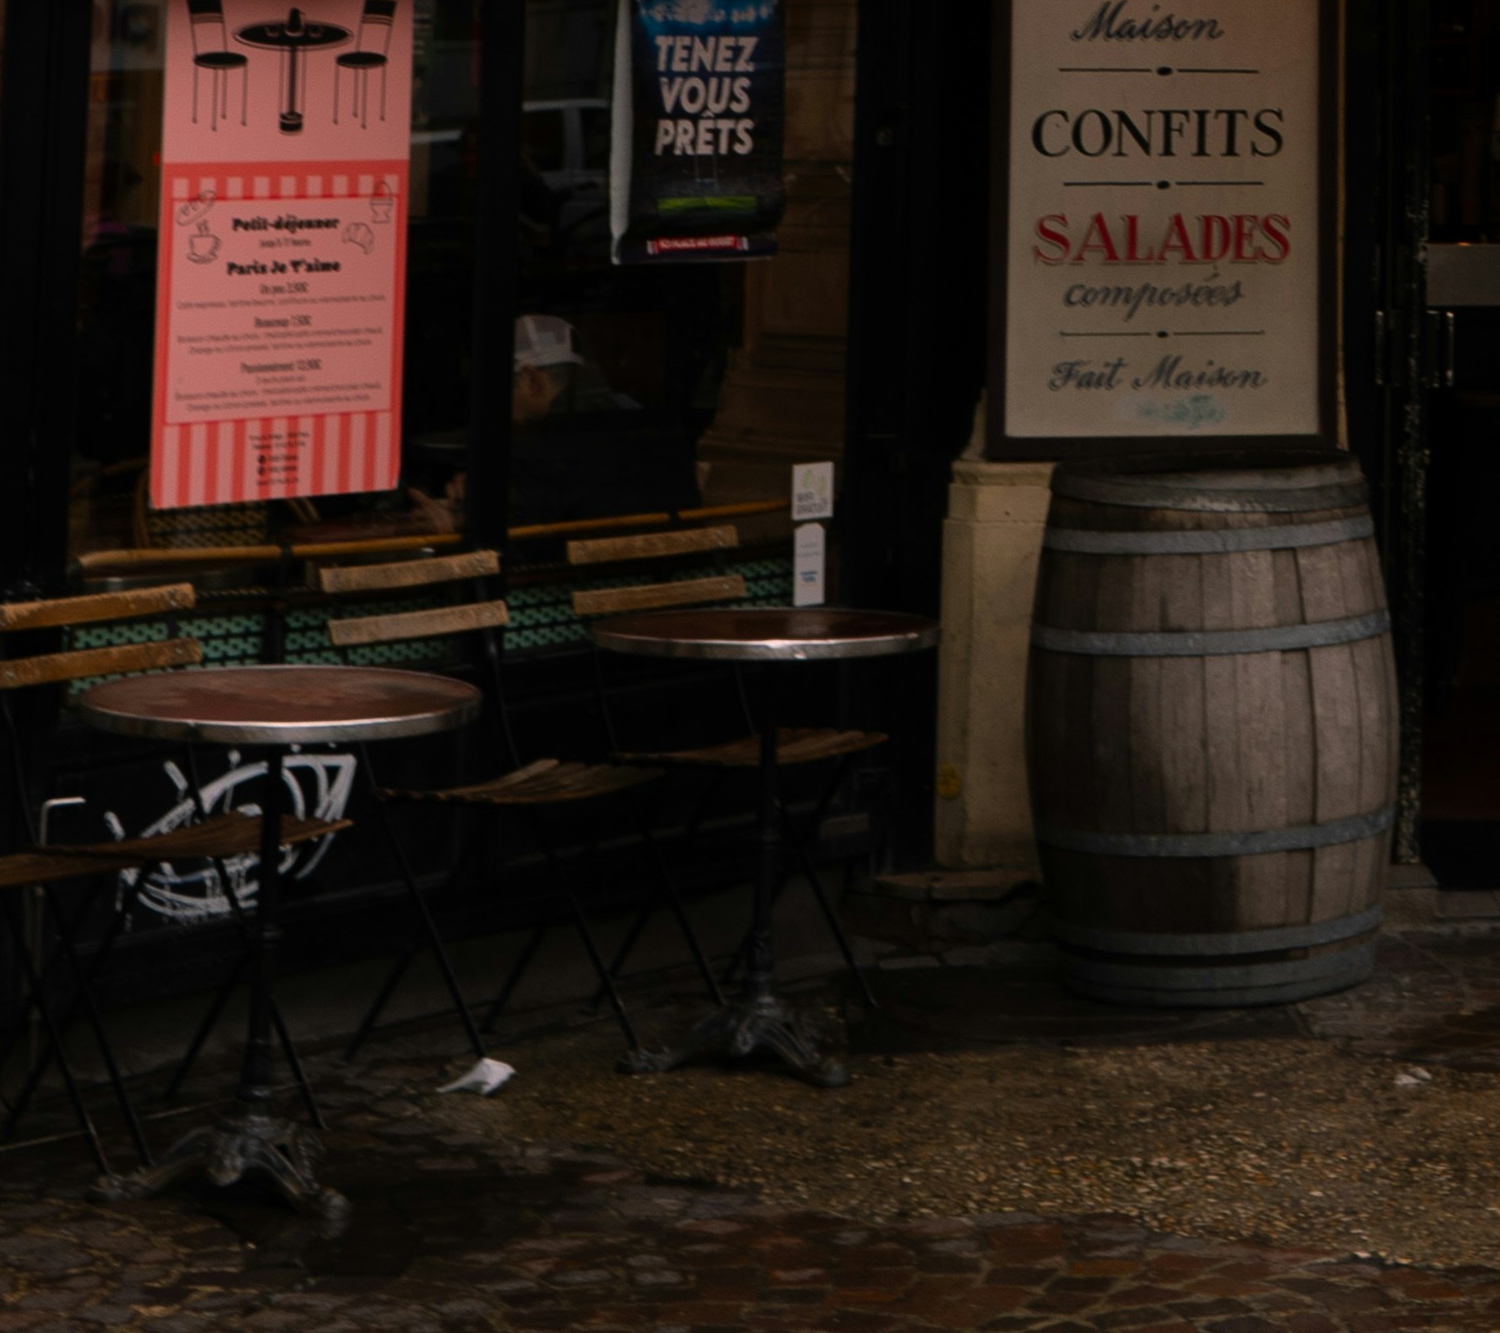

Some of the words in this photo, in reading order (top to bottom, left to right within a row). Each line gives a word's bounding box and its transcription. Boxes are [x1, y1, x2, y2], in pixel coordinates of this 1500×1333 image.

[1069, 0, 1225, 42] Maison
[654, 35, 761, 73] TENEZ
[658, 76, 753, 116] VOUS
[653, 111, 756, 157] PRÊTS
[1031, 108, 1284, 158] CONFITS
[1033, 212, 1292, 265] SALADES
[1048, 356, 1126, 391] Fait
[1131, 353, 1269, 389] Maison
